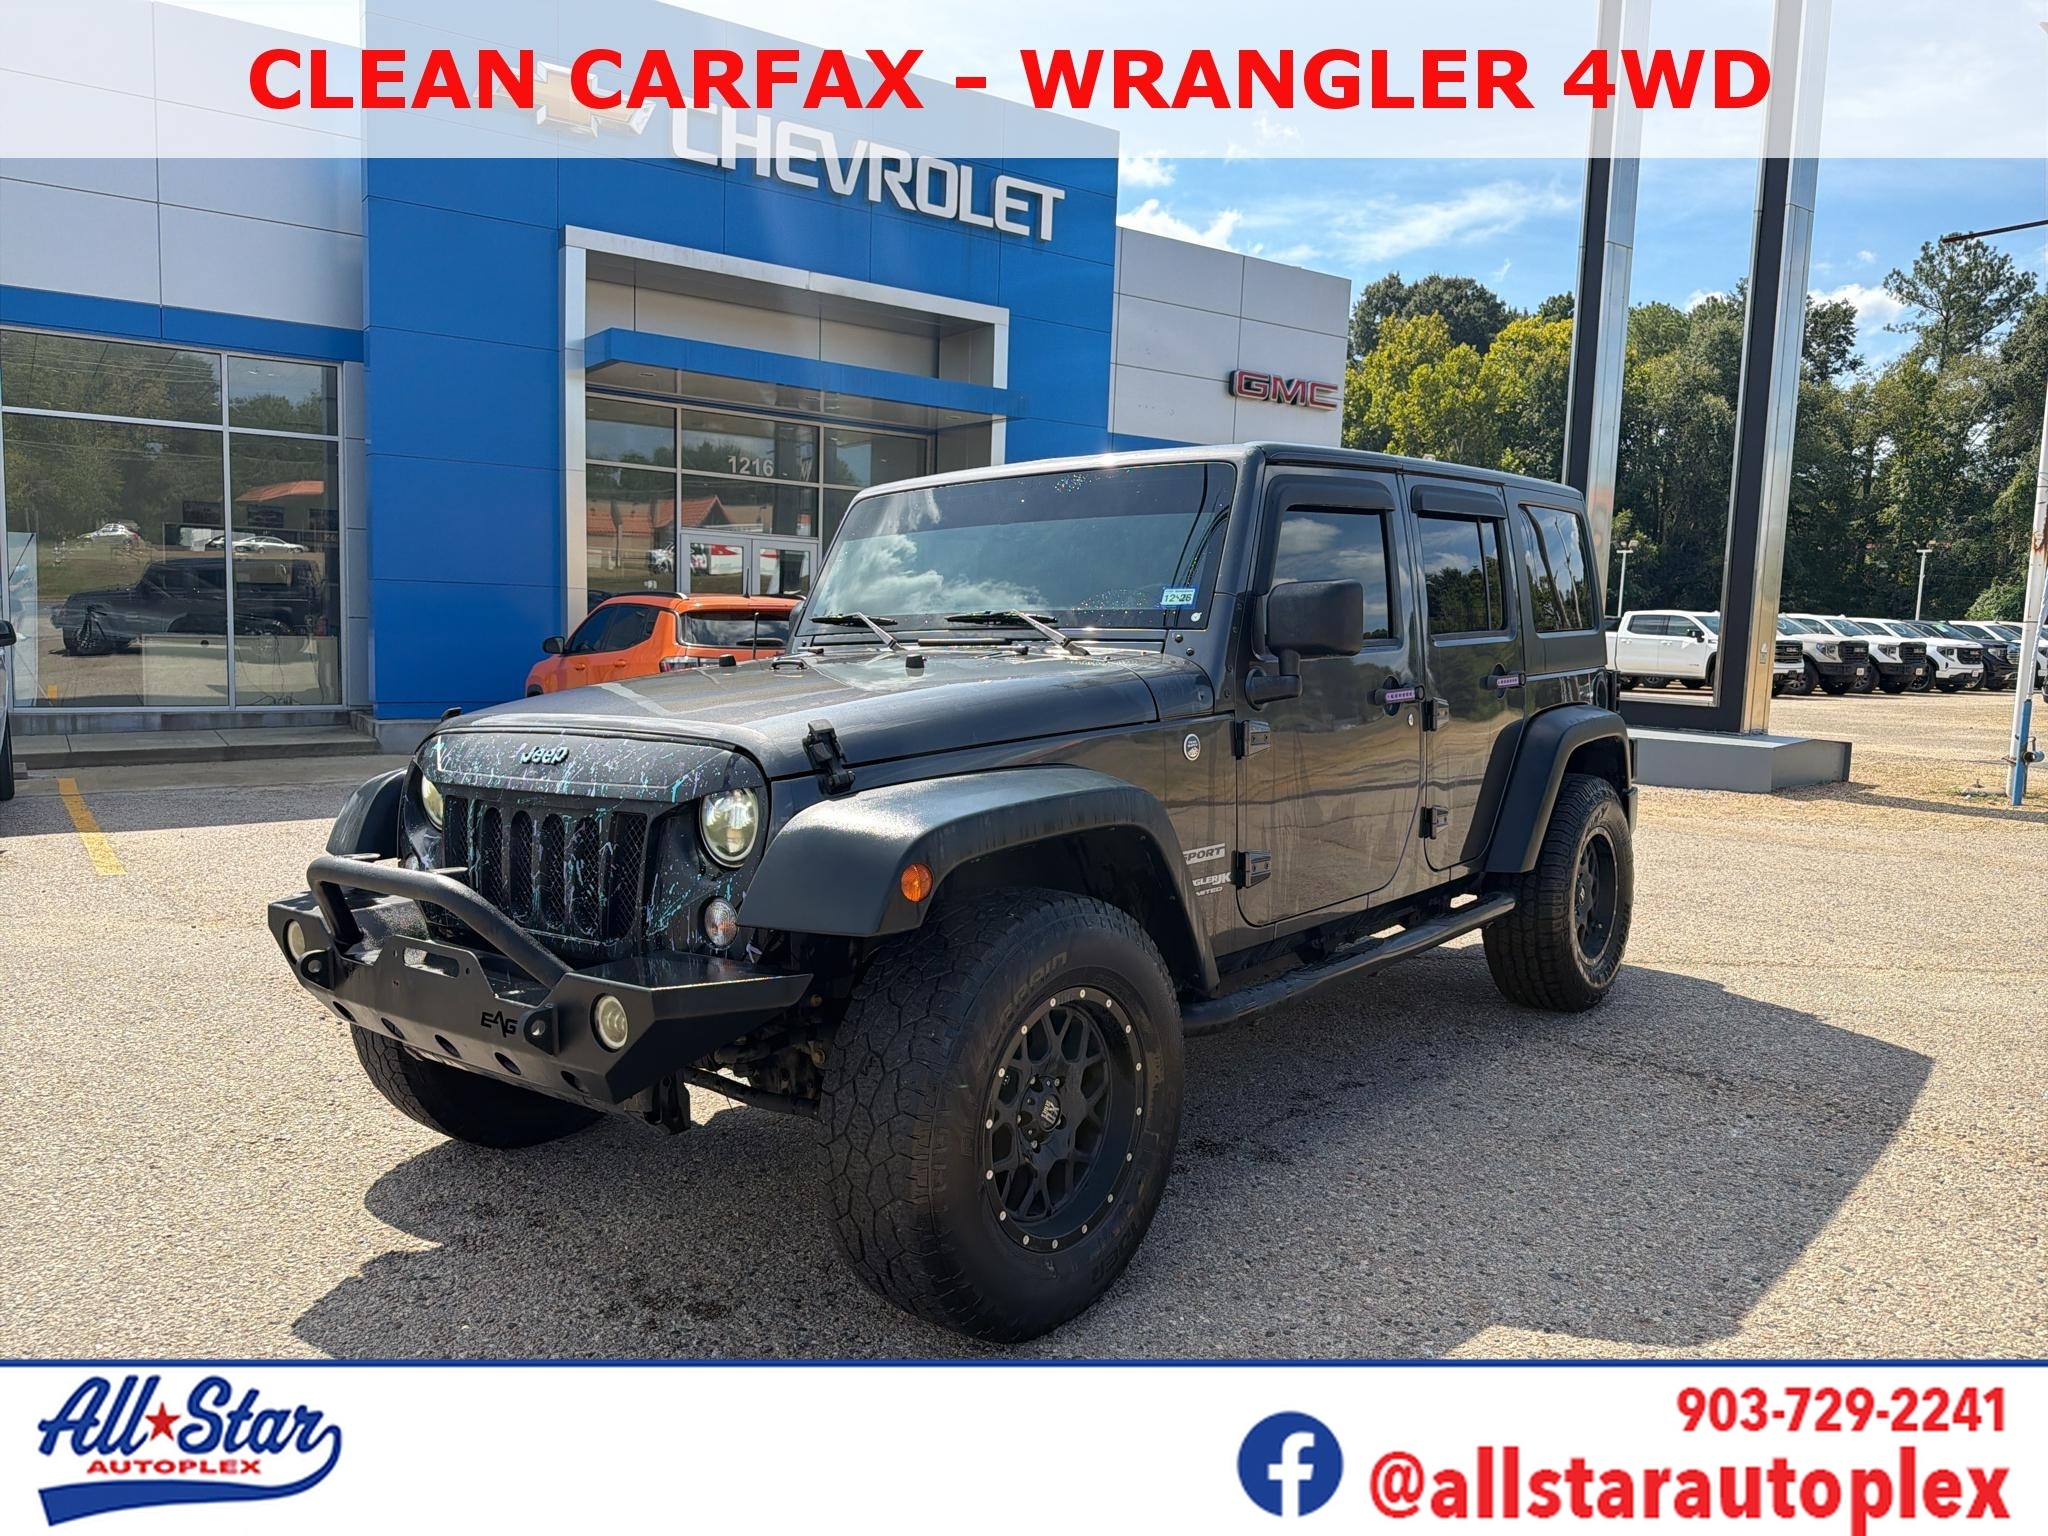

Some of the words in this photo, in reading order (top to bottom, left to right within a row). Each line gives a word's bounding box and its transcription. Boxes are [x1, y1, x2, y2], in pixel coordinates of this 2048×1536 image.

[671, 103, 1066, 242] CHEVROLET
[1230, 369, 1339, 411] GMC
[727, 455, 775, 477] 1216
[520, 745, 570, 766] Jeep
